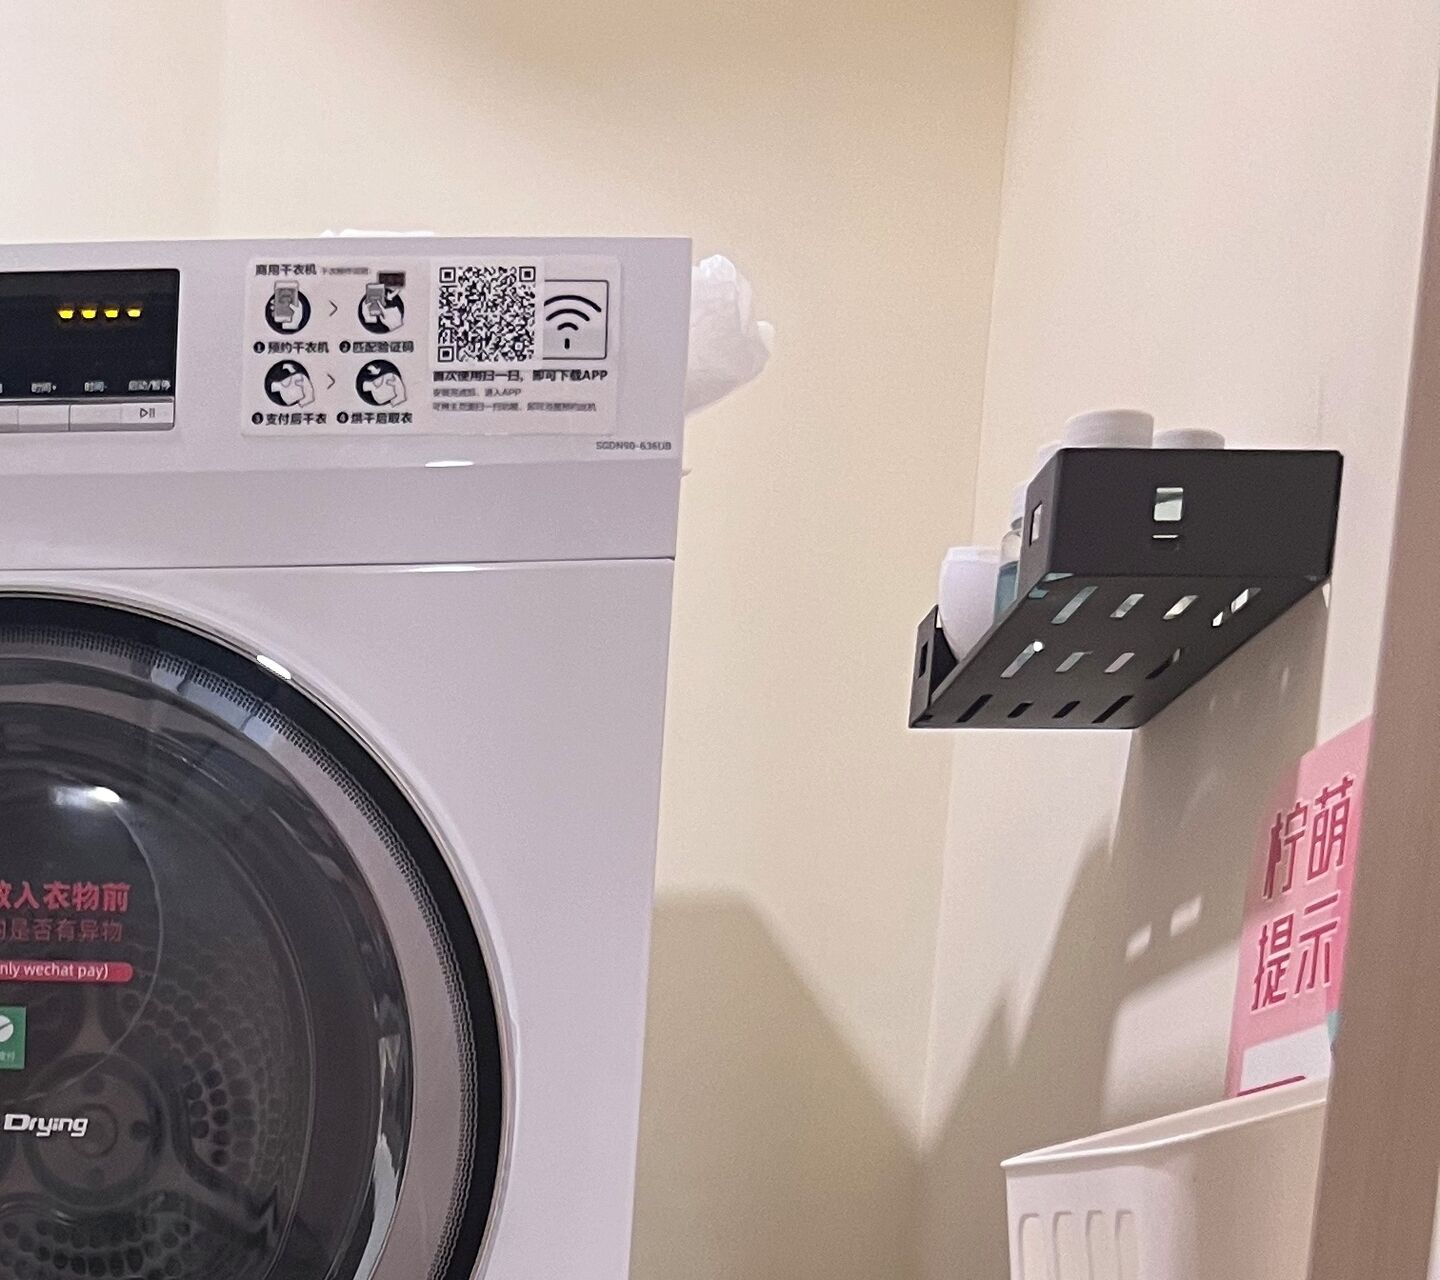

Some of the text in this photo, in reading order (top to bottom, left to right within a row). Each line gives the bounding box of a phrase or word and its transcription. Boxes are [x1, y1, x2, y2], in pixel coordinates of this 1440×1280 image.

[255, 263, 317, 276] 商用干衣机
[267, 341, 329, 354] 预约干衣机
[352, 340, 415, 353] 匹配验证码
[266, 412, 327, 425] 支付后干衣
[1263, 775, 1354, 899] 柠萌
[1251, 892, 1339, 1011] 提示
[23, 962, 74, 977] wechat
[77, 964, 109, 980] pay)
[3, 1114, 89, 1137] Drying
